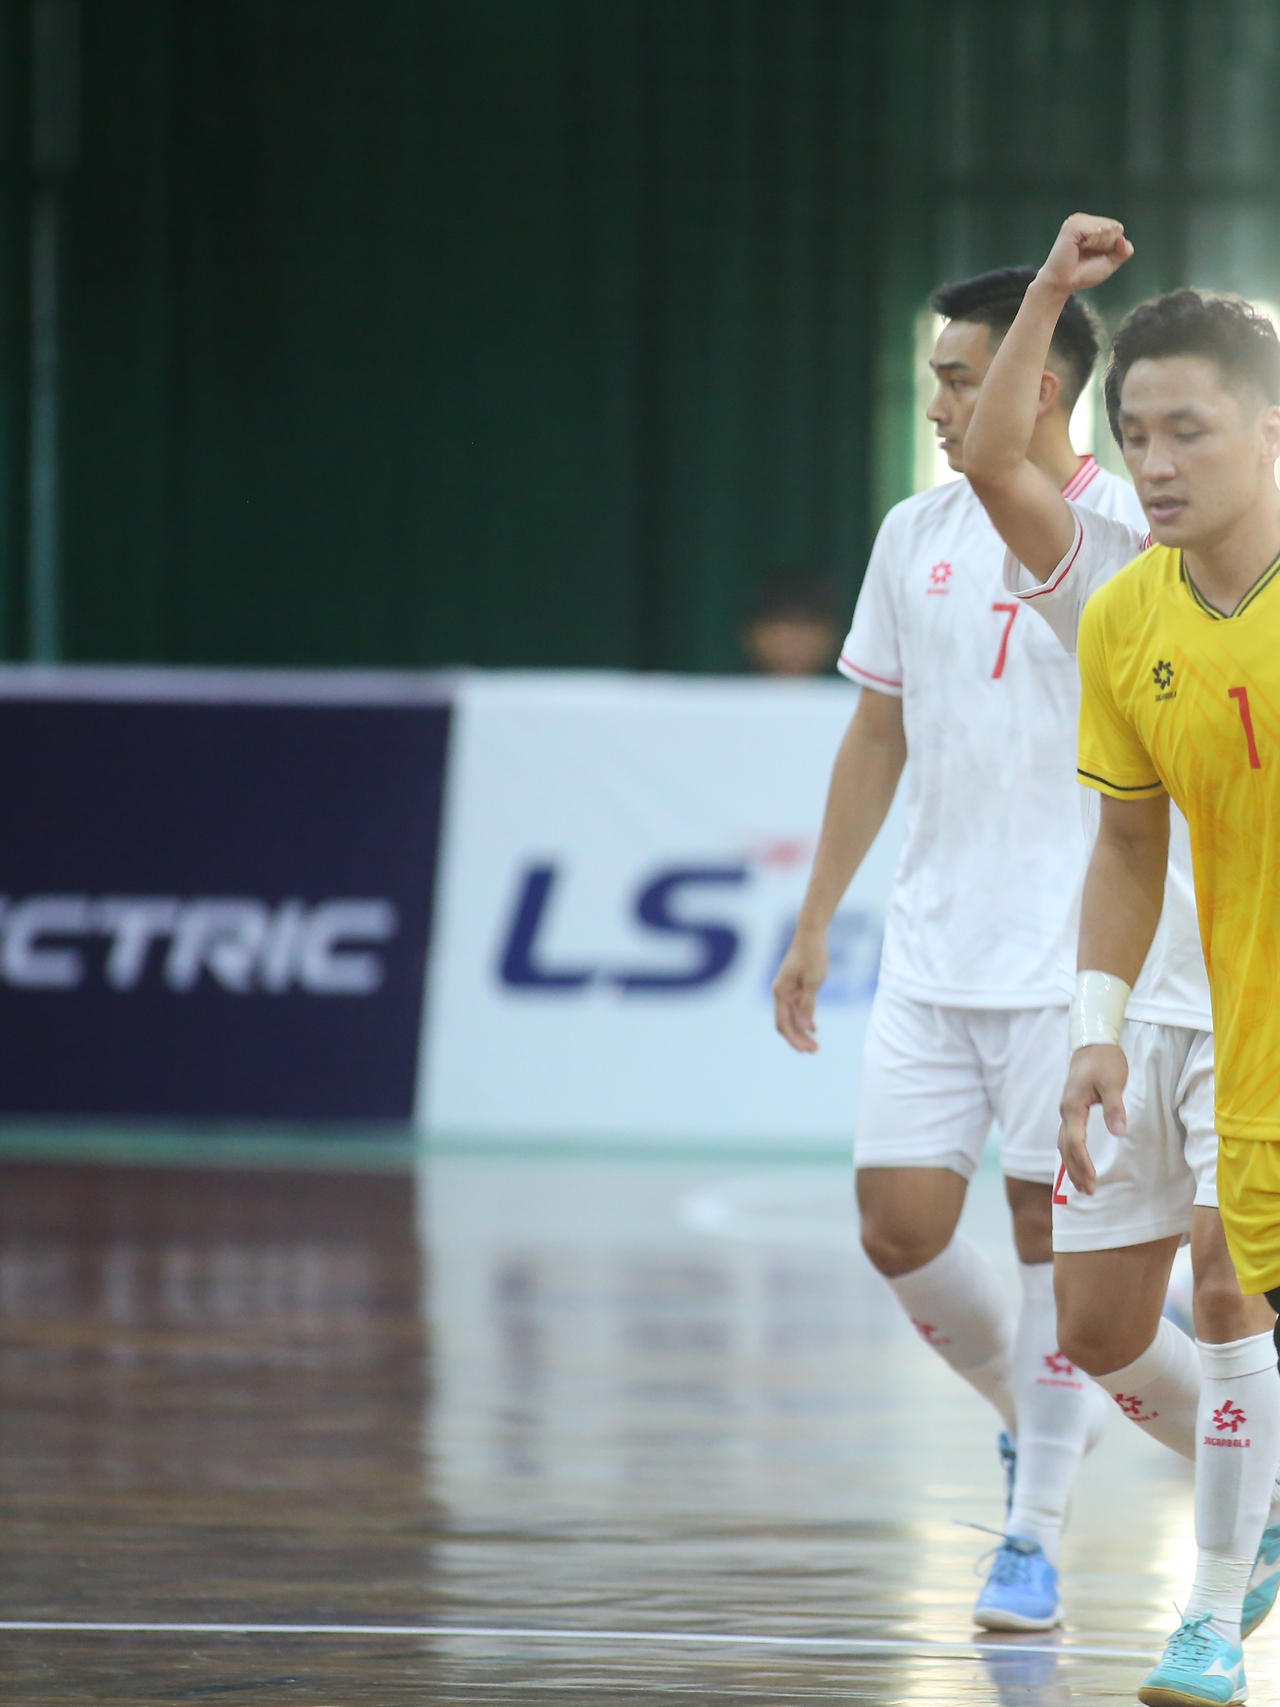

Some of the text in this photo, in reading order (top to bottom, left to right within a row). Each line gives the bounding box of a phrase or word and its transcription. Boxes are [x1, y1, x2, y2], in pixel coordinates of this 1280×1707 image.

[991, 602, 1019, 680] 7
[1228, 687, 1261, 769] 1
[0, 894, 396, 993] CTRIC
[499, 863, 750, 995] LS
